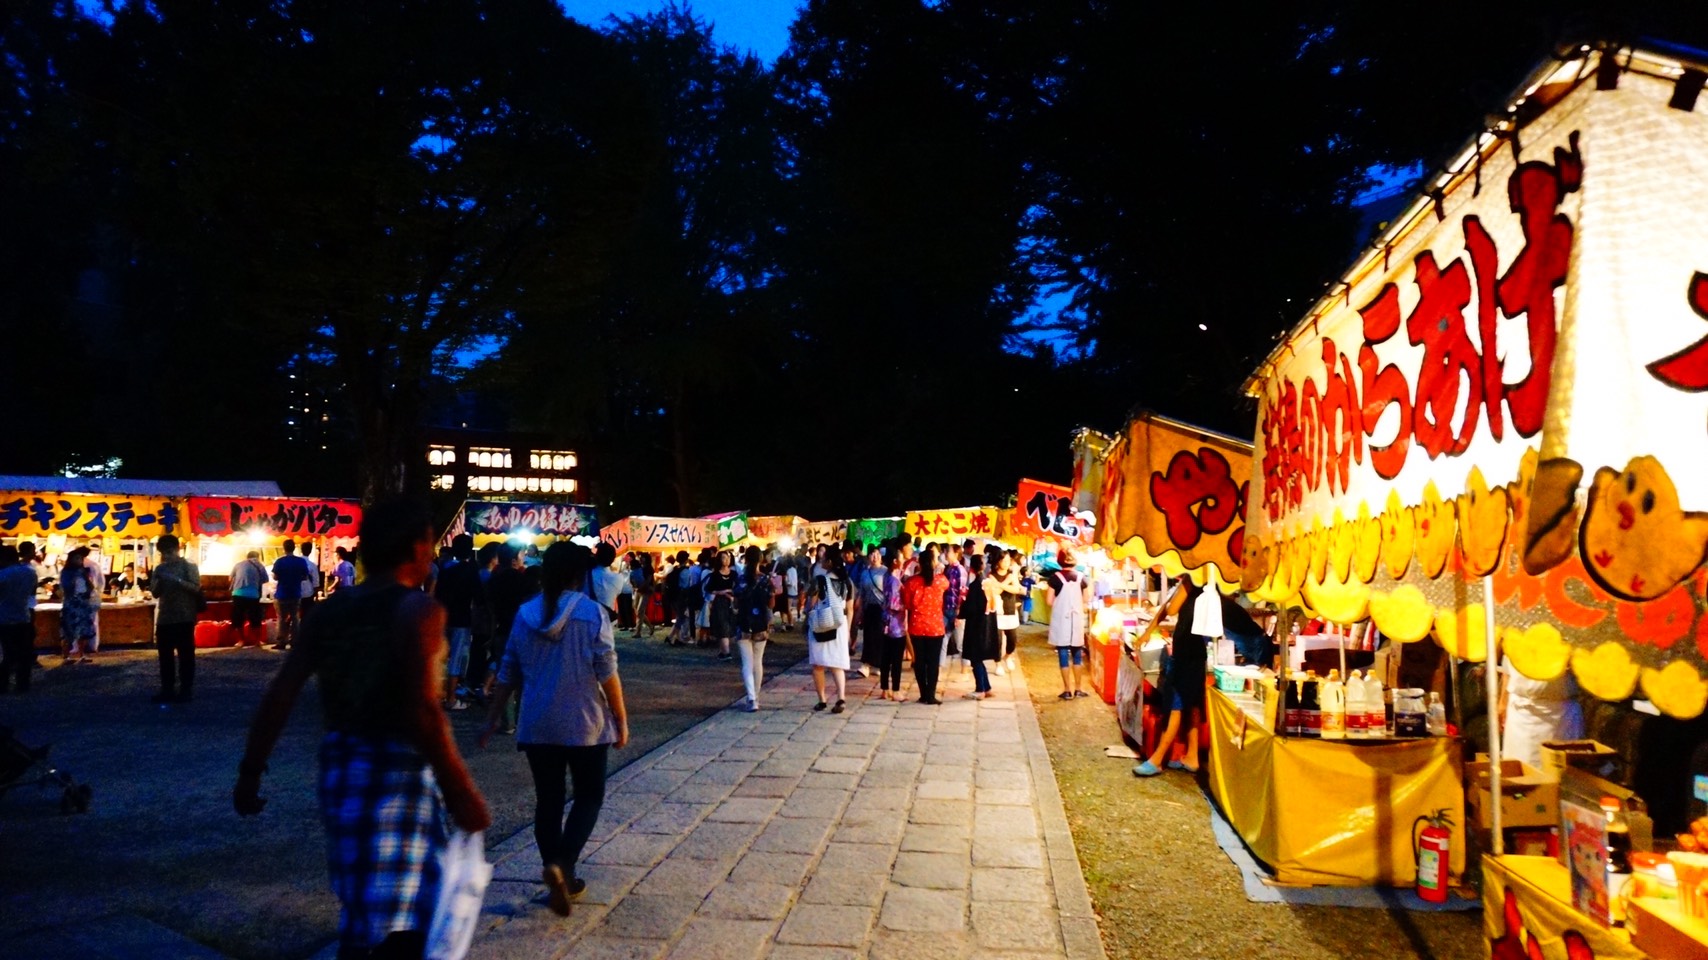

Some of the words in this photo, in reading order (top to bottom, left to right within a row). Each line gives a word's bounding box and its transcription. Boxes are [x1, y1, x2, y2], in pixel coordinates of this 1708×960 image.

[0, 498, 179, 533] チキンステーキ
[488, 505, 579, 533] あゆの塩焼
[915, 511, 991, 535] 大たこ焼
